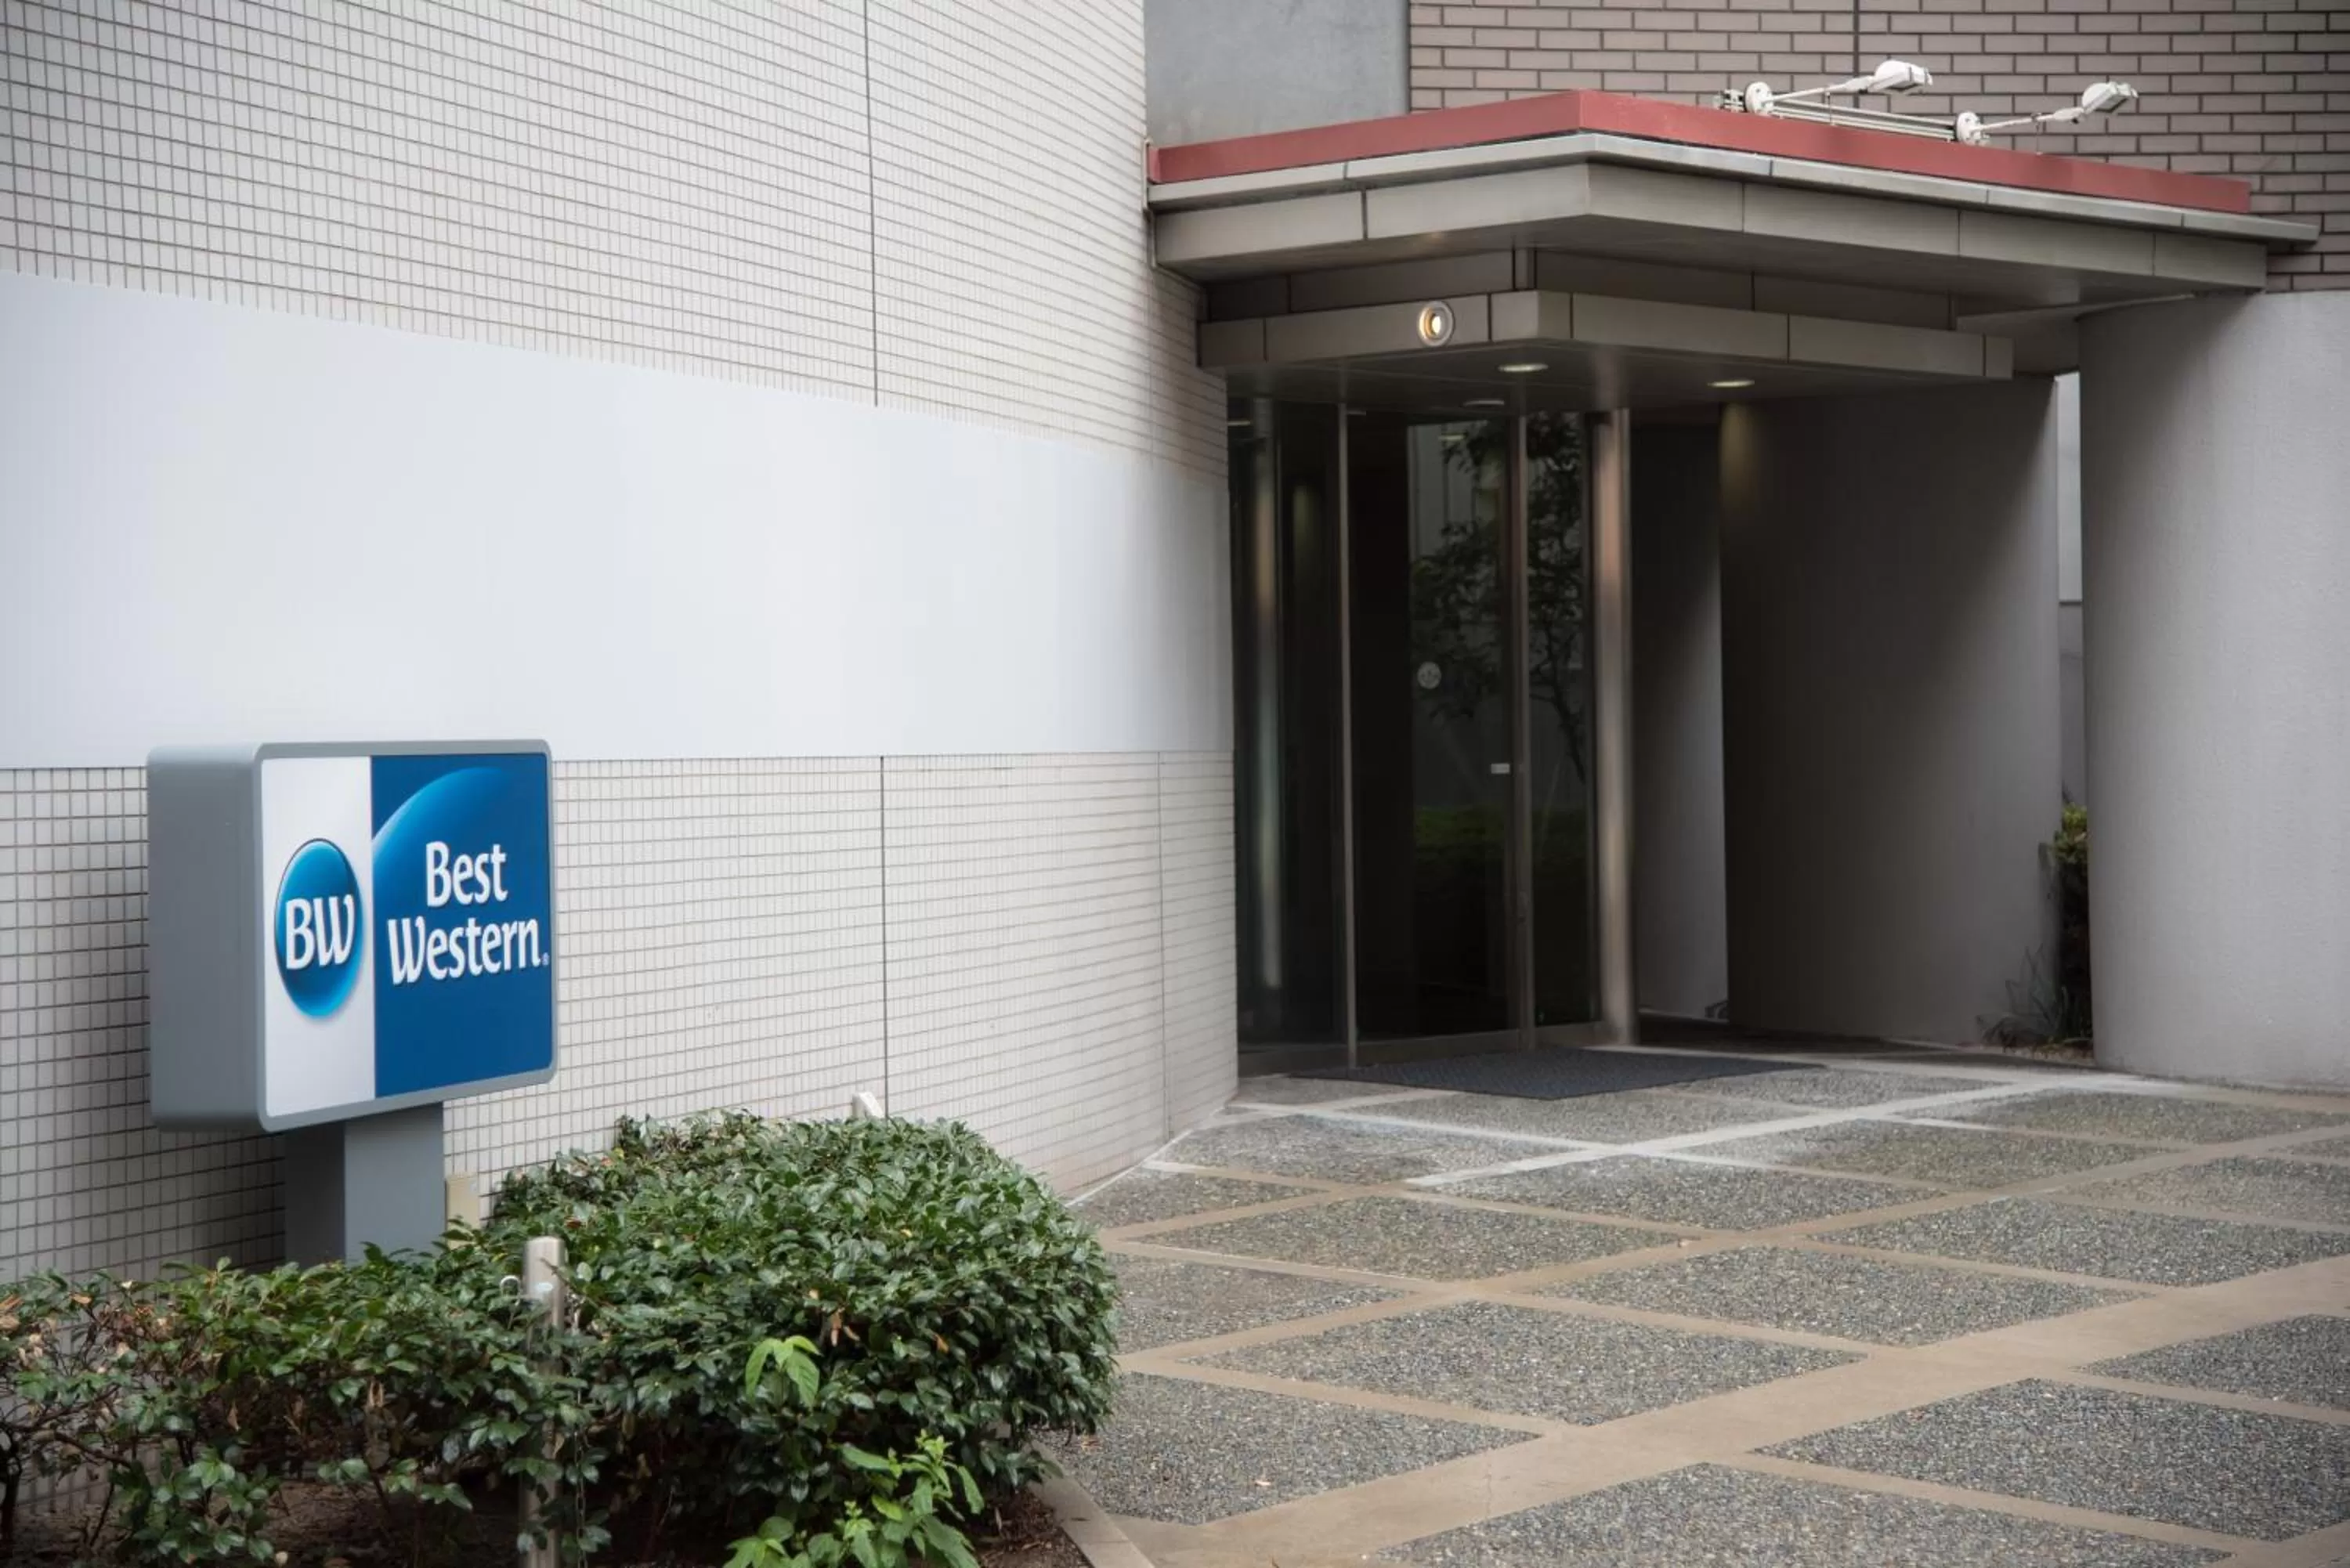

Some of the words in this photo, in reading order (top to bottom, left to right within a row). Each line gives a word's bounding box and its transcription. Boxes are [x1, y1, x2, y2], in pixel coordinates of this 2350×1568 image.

[425, 840, 508, 907] Best
[285, 894, 355, 970] BW
[388, 915, 541, 985] Western
